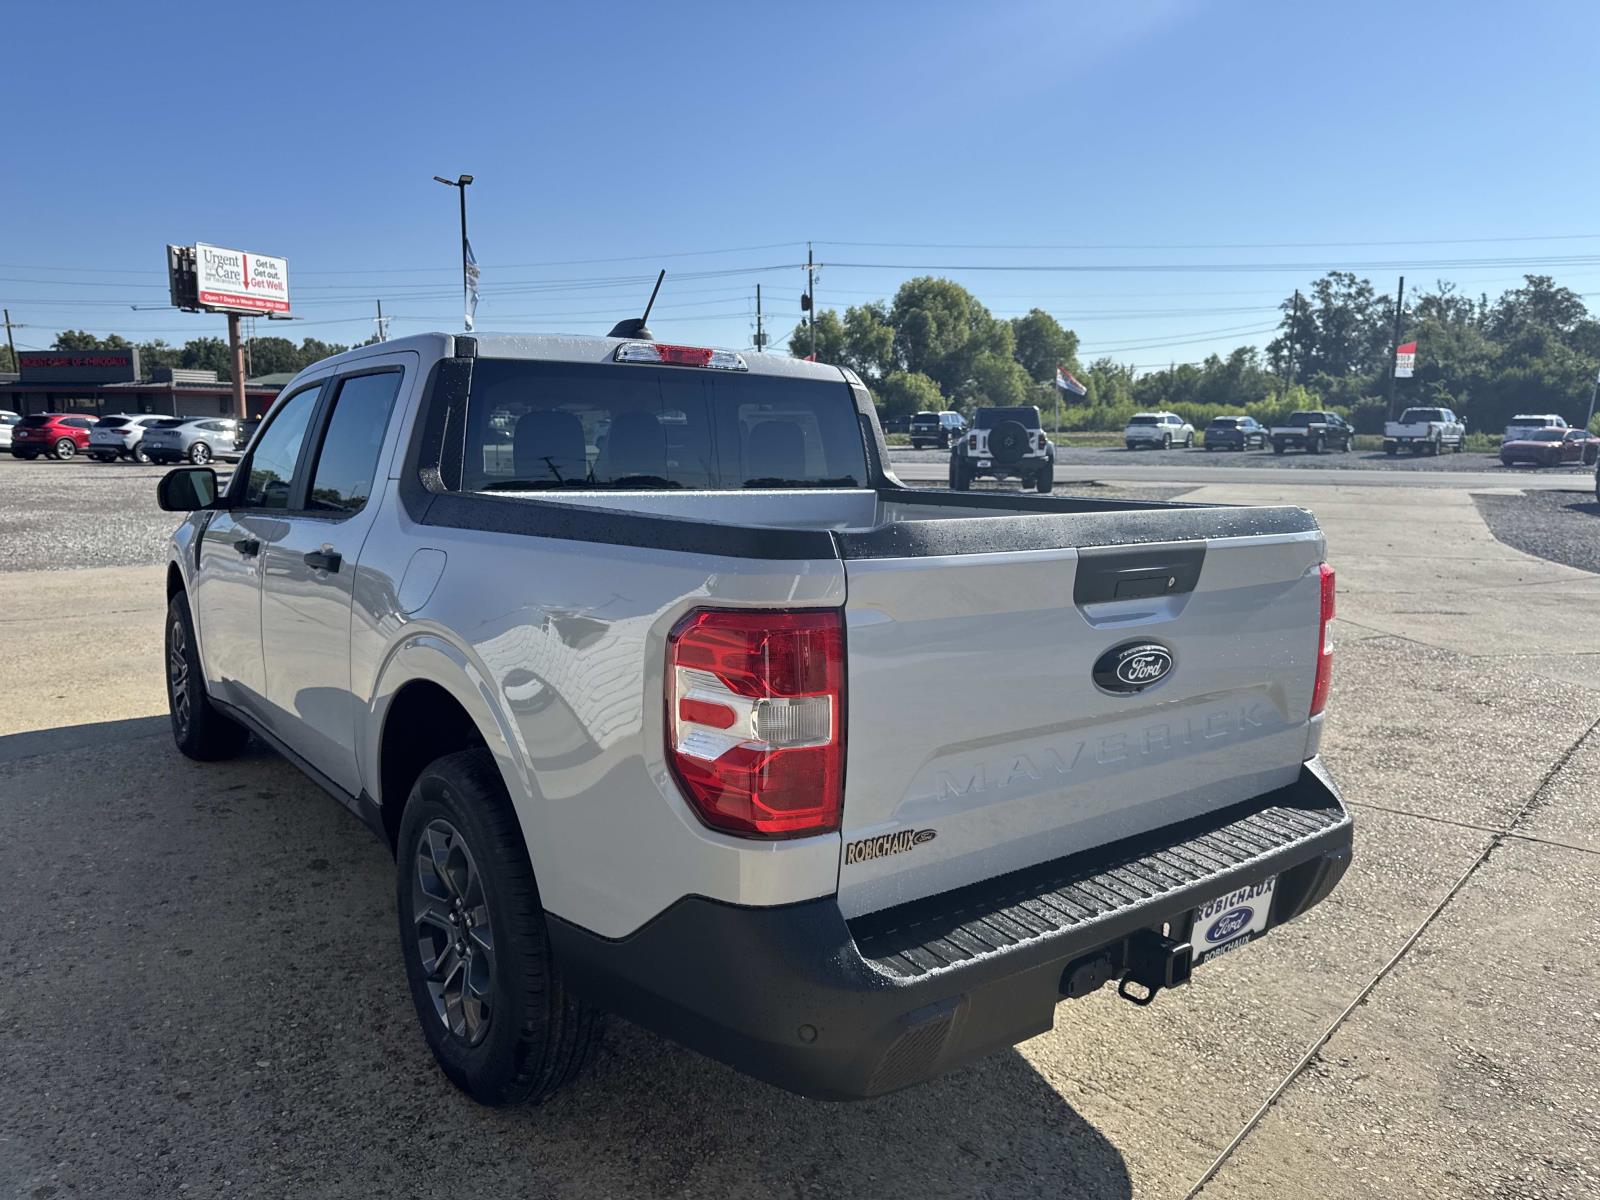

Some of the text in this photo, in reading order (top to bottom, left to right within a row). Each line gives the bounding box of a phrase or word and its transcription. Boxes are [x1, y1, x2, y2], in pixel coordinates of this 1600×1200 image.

[204, 250, 239, 268] Urgent
[256, 259, 277, 270] Get in.
[216, 263, 240, 280] Care
[254, 268, 280, 280] Get out.
[251, 277, 266, 288] Get
[266, 279, 284, 291] Well.
[1128, 655, 1162, 680] Ford
[936, 702, 1264, 800] MAVERICK
[845, 829, 915, 865] ROBICHAUX
[919, 832, 933, 842] Ford
[1194, 879, 1273, 923] ROBICHAUX
[1214, 912, 1244, 938] Ford
[1203, 935, 1251, 962] ROBICHAUX
